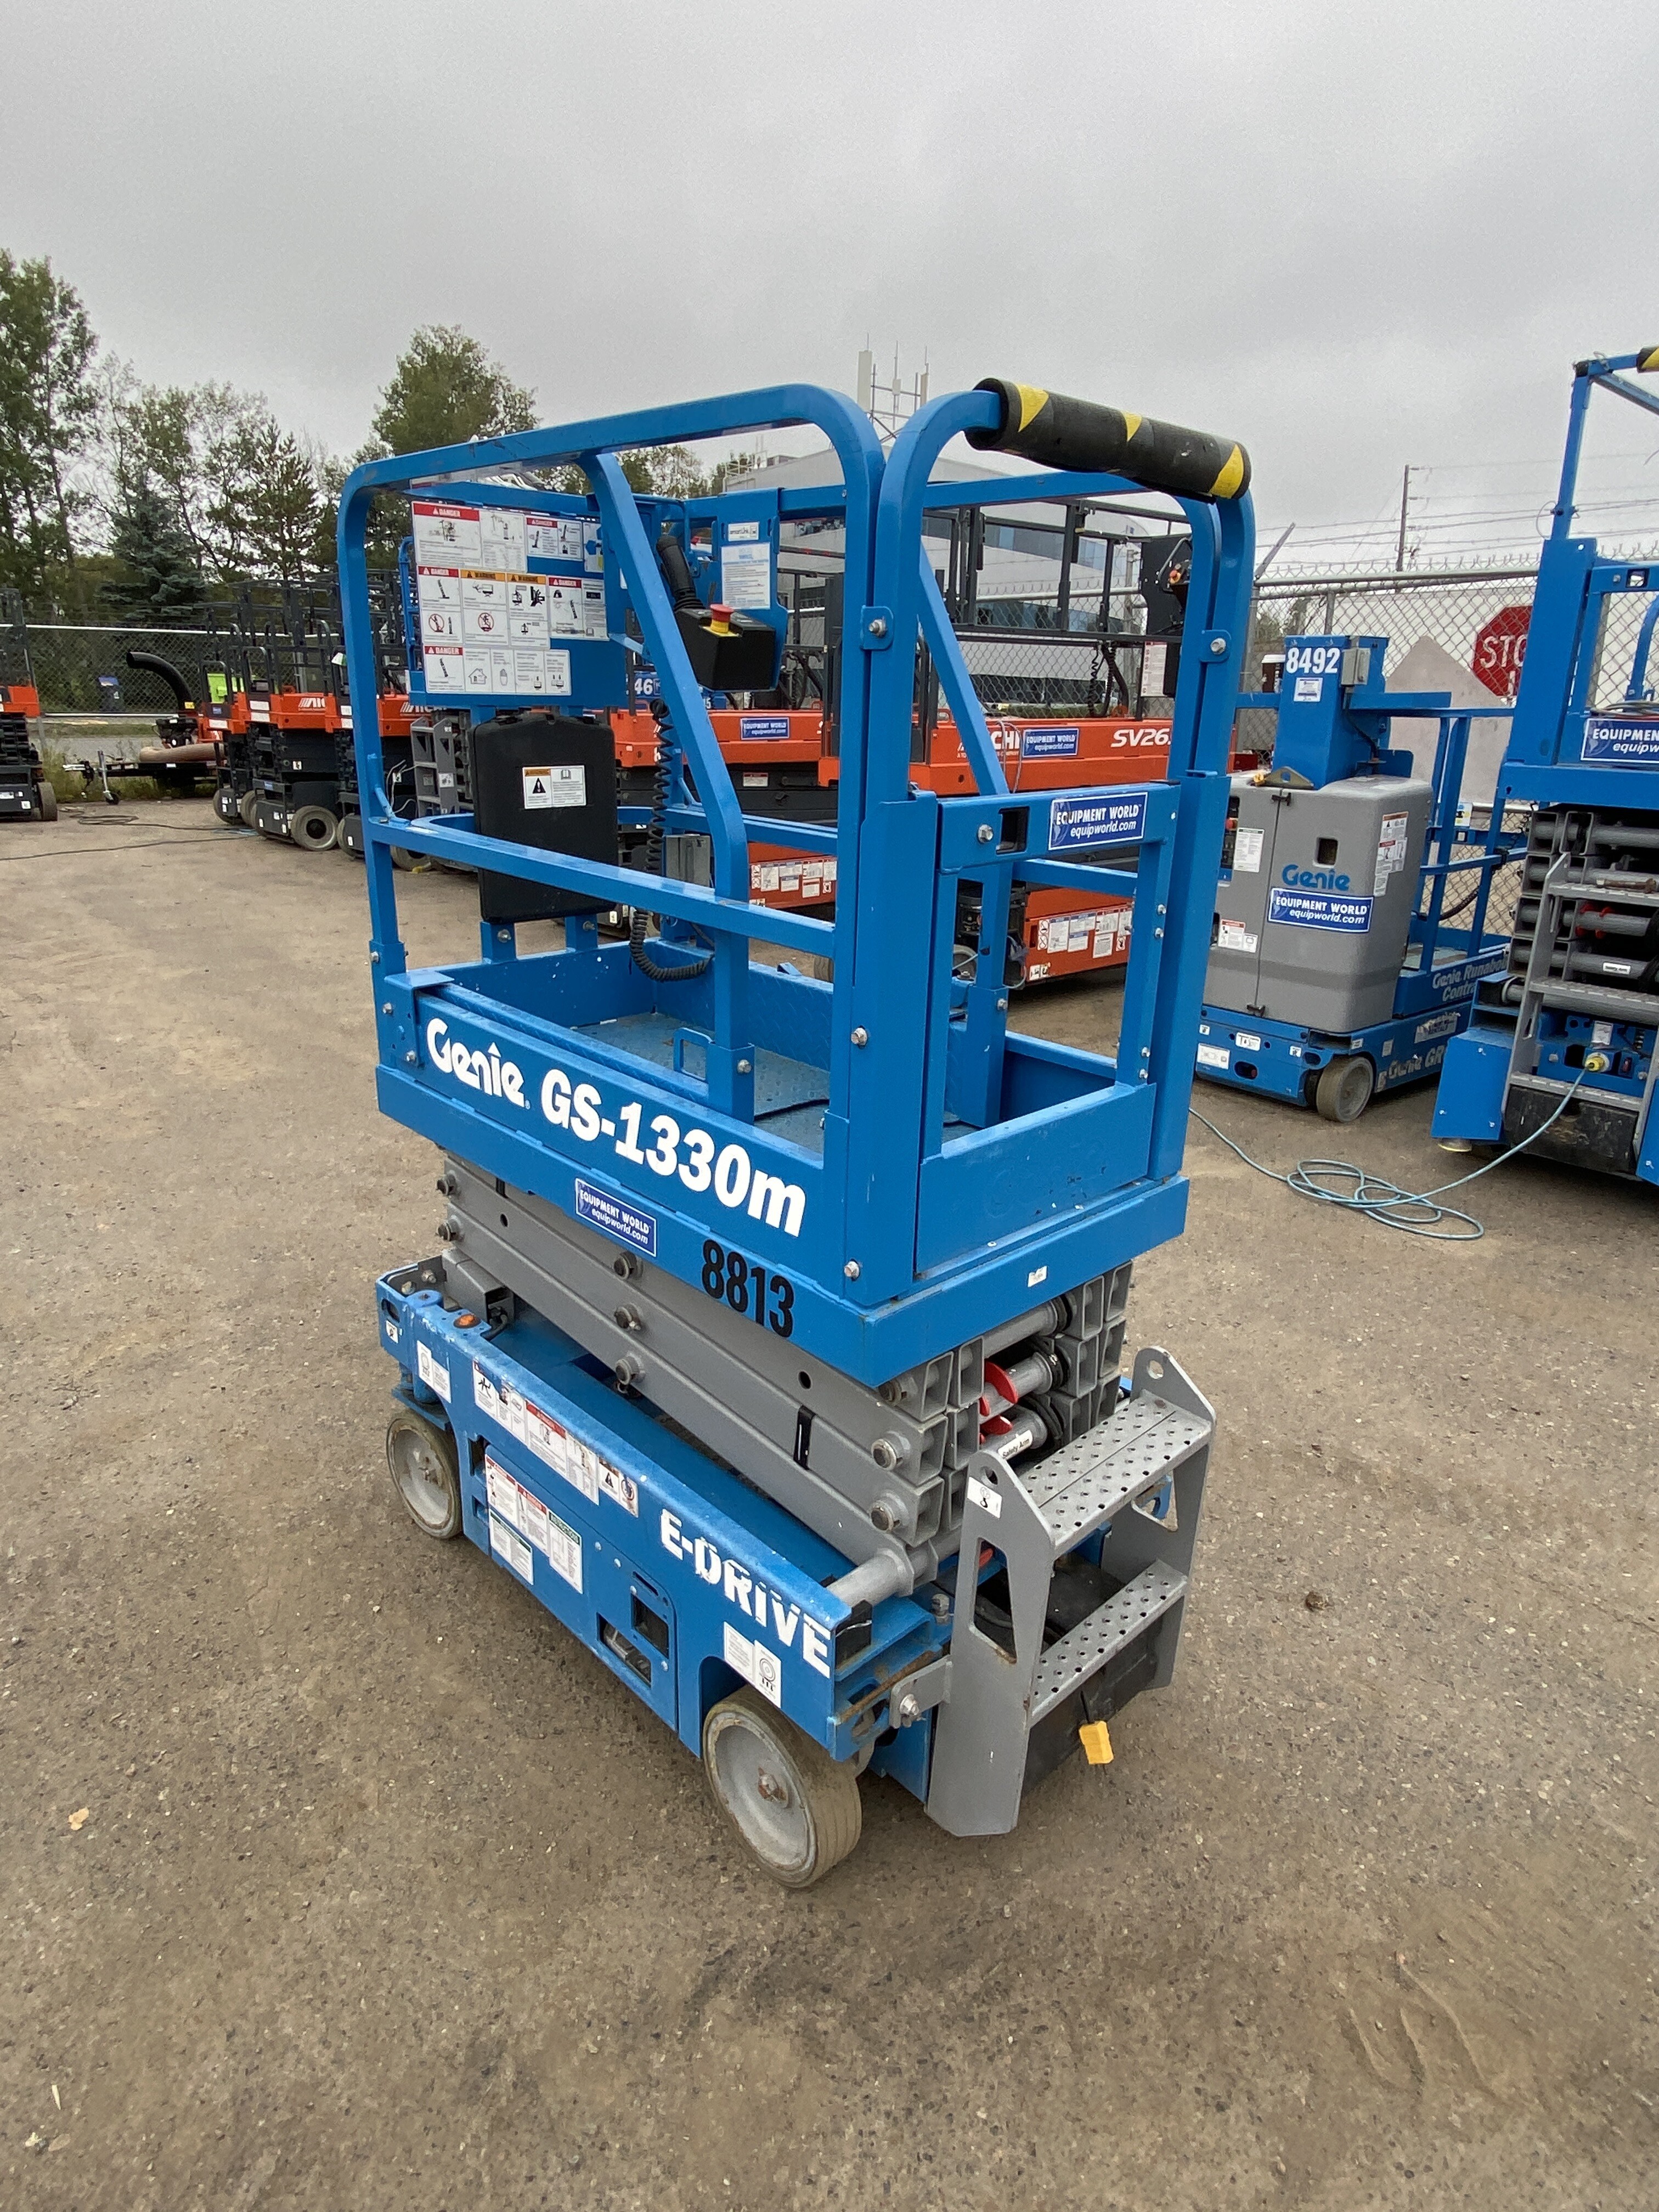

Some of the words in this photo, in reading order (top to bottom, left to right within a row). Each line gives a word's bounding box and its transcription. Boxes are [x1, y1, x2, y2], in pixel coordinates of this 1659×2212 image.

[435, 647, 459, 655] DANGER
[1286, 647, 1340, 674] 8492
[1480, 634, 1528, 668] STO
[1026, 735, 1056, 743] EQUIPMENT
[1057, 734, 1076, 742] WORLD
[1034, 743, 1074, 752] equipworld.com
[1110, 728, 1171, 748] SV26
[1056, 807, 1107, 825] EQUIPMENT
[1109, 804, 1139, 820] WORLD
[1070, 820, 1137, 839] equipworld.com
[1282, 864, 1350, 891] Genie
[1276, 896, 1328, 911] EQUIPMENT
[1330, 902, 1367, 915] WORLD
[1290, 909, 1365, 924] equipworld.com
[427, 1018, 524, 1108] Genie
[541, 1069, 808, 1237] GS-1330m
[579, 1189, 620, 1218] EQUIPMENT
[622, 1211, 650, 1234] WORLD
[591, 1208, 648, 1244] equipworld.com
[702, 1239, 794, 1338] 8813
[1002, 1445, 1019, 1459] Safety
[1019, 1438, 1030, 1449] Arm
[661, 1509, 831, 1679] E-DRIVE
